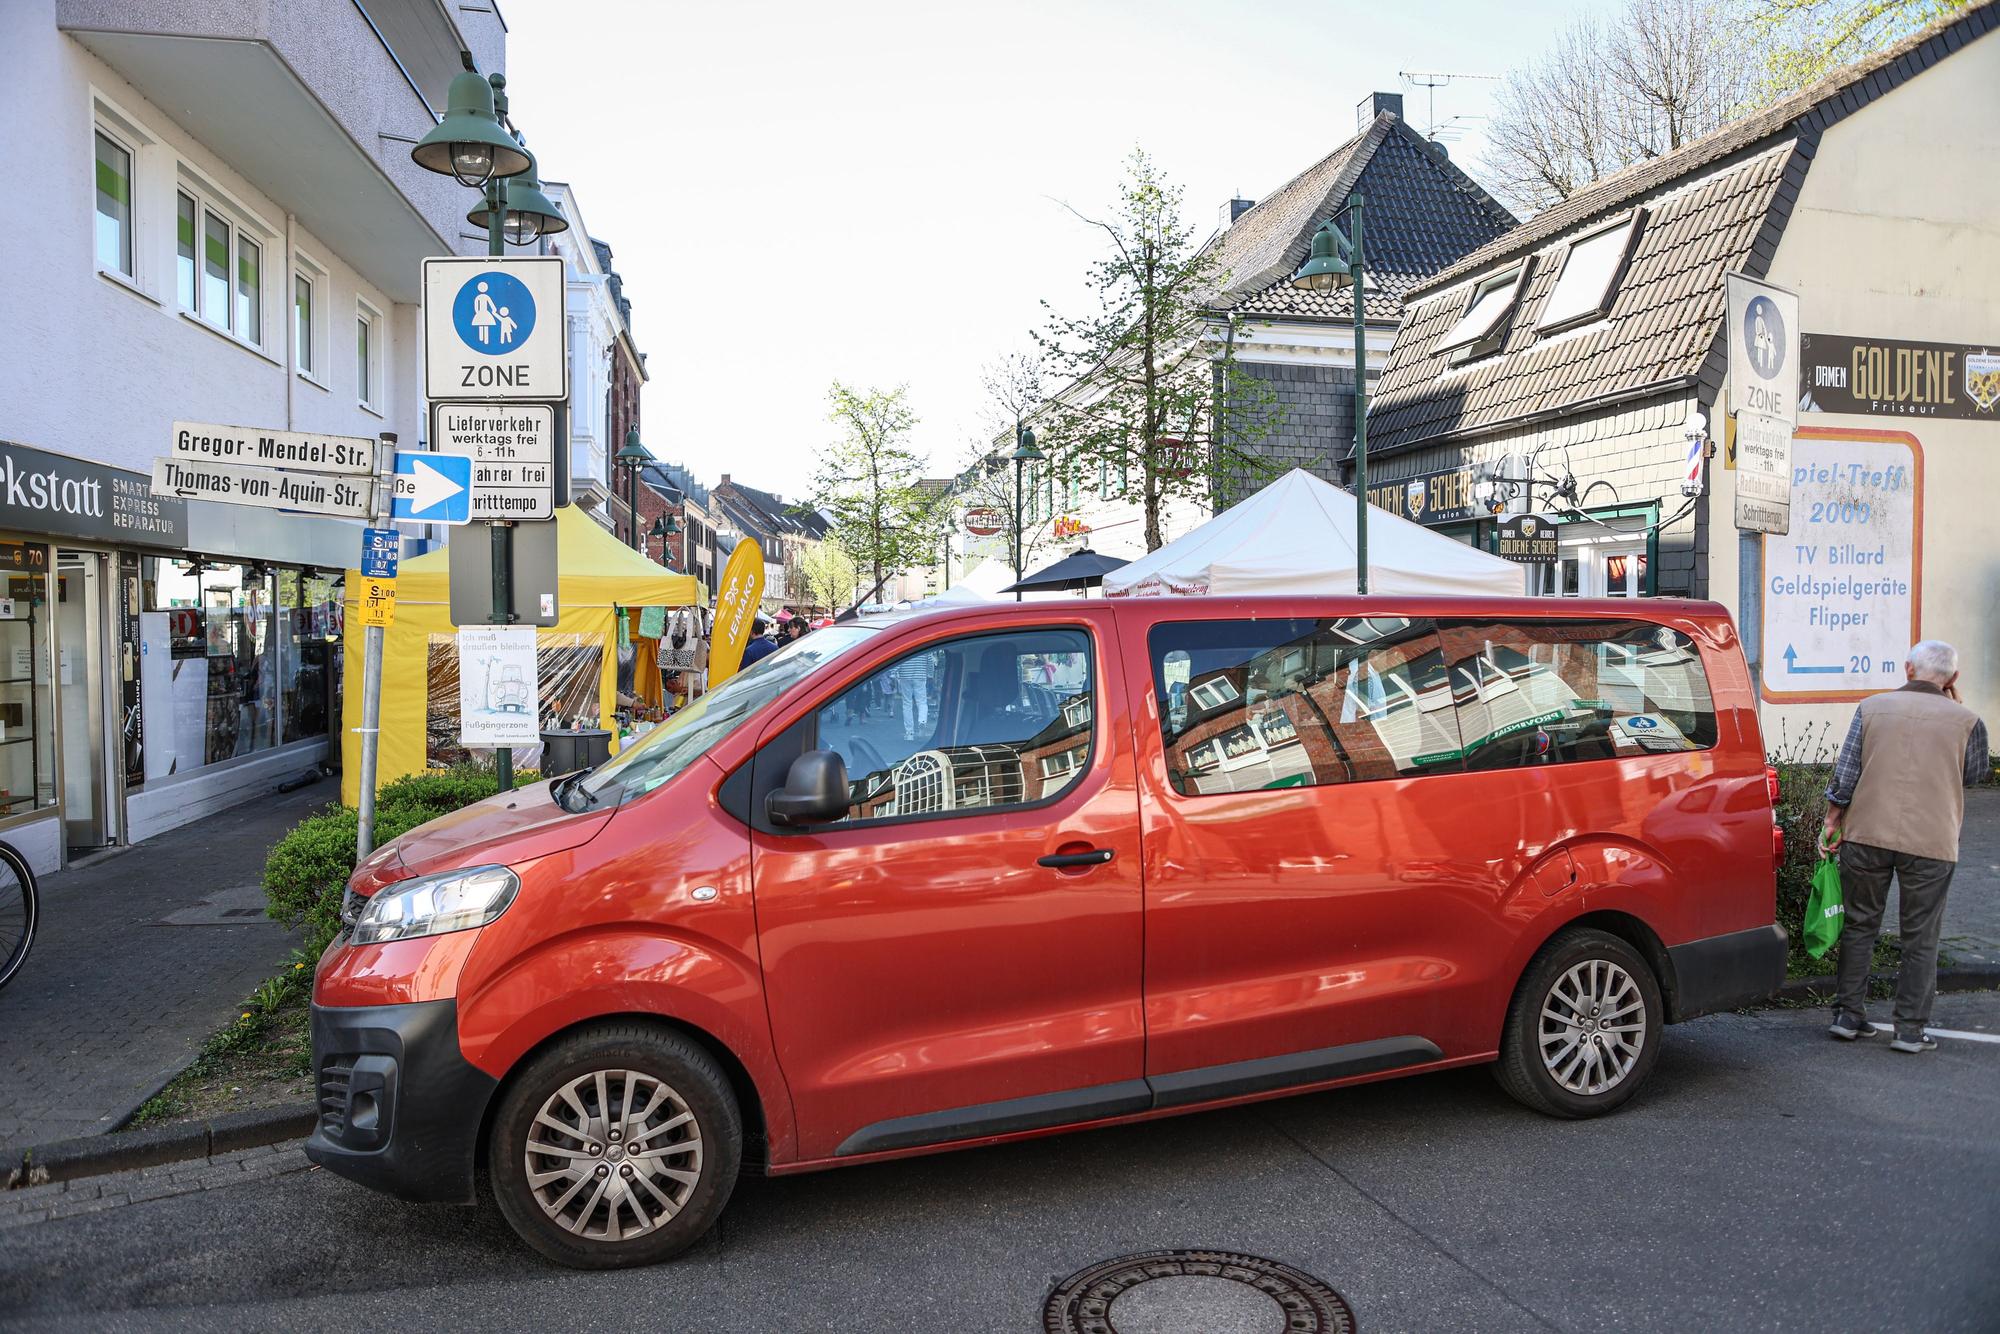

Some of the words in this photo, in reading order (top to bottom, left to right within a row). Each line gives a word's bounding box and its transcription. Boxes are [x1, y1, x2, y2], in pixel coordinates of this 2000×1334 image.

[461, 365, 530, 387] ZONE
[1815, 366, 1846, 388] DAMEN
[1852, 345, 1956, 404] GOLDENE
[1748, 386, 1782, 414] ZONE
[1872, 400, 1936, 415] Friseur
[448, 415, 541, 432] Lieferverkehr
[178, 430, 368, 467] Gregor-Mendel-Str.
[452, 433, 512, 446] werktags
[516, 433, 537, 445] frei
[1744, 442, 1773, 459] werktags
[1774, 448, 1785, 460] frei
[522, 466, 545, 482] frei
[1792, 463, 1905, 490] piel-Treff
[165, 464, 363, 508] Thomas-von-Aquin-Str.
[396, 479, 416, 494] ße
[1430, 470, 1474, 512] SCHERE
[113, 496, 159, 516] EXPRESS
[1438, 512, 1460, 520] salon
[1744, 504, 1782, 526] Schritttempo
[1808, 502, 1871, 524] 2000
[113, 512, 174, 534] REPARATUR
[374, 536, 382, 548] S
[384, 541, 398, 549] 100
[1500, 540, 1530, 554] GOLDENE
[1532, 540, 1556, 554] SCHERE
[28, 550, 42, 565] 70
[1796, 546, 1817, 565] TV
[1828, 544, 1884, 565] Billard
[371, 586, 379, 596] S
[381, 590, 395, 598] 100
[1771, 575, 1907, 602] Geldspielgeräte
[728, 574, 754, 646] JEMAKO
[1810, 606, 1869, 632] Flipper
[1850, 655, 1871, 674] 20
[1882, 661, 1896, 673] m
[465, 721, 528, 730] Fußgängerzone
